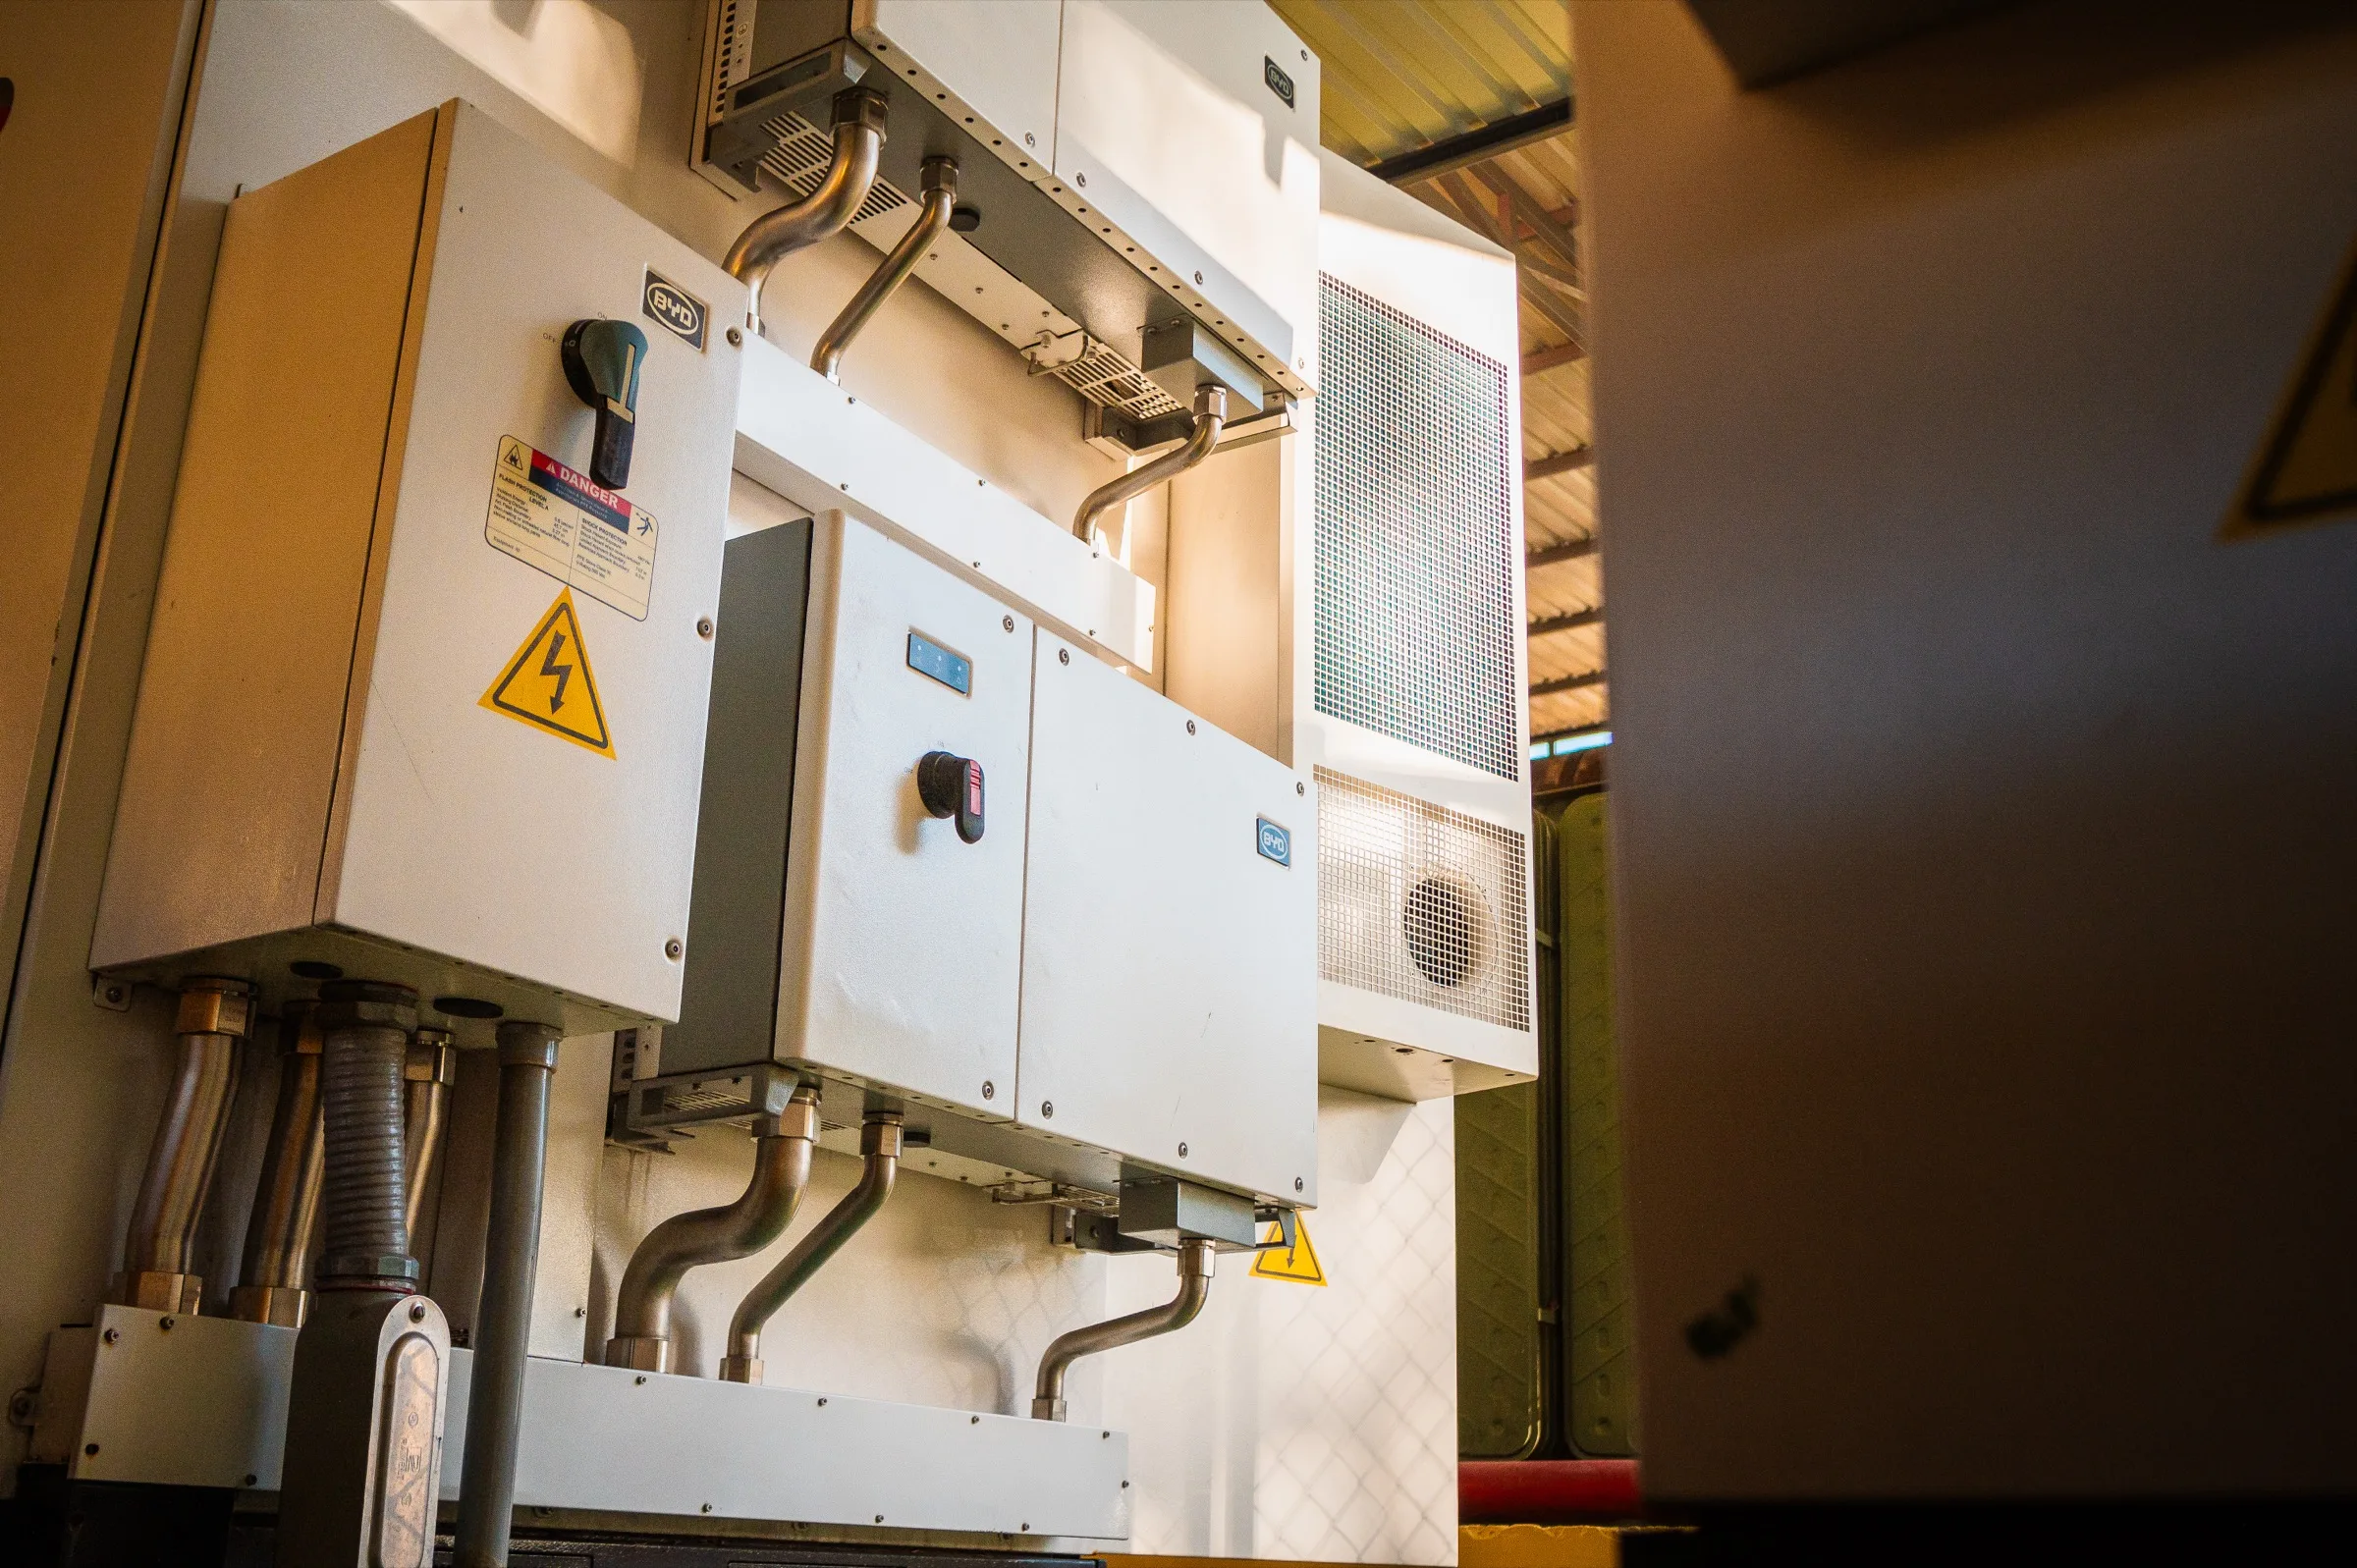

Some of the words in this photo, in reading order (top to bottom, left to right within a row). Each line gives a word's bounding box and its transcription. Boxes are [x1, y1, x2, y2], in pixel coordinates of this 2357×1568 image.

[1271, 69, 1289, 95] BYD
[653, 289, 692, 328] BYD
[498, 471, 516, 487] FLASH
[515, 480, 547, 503] PROTECTION
[528, 495, 545, 510] LEVEL
[560, 466, 619, 510] DANGER
[581, 516, 599, 530] SHOCK
[597, 525, 628, 547] PROTECTION
[1263, 831, 1285, 853] BYD
